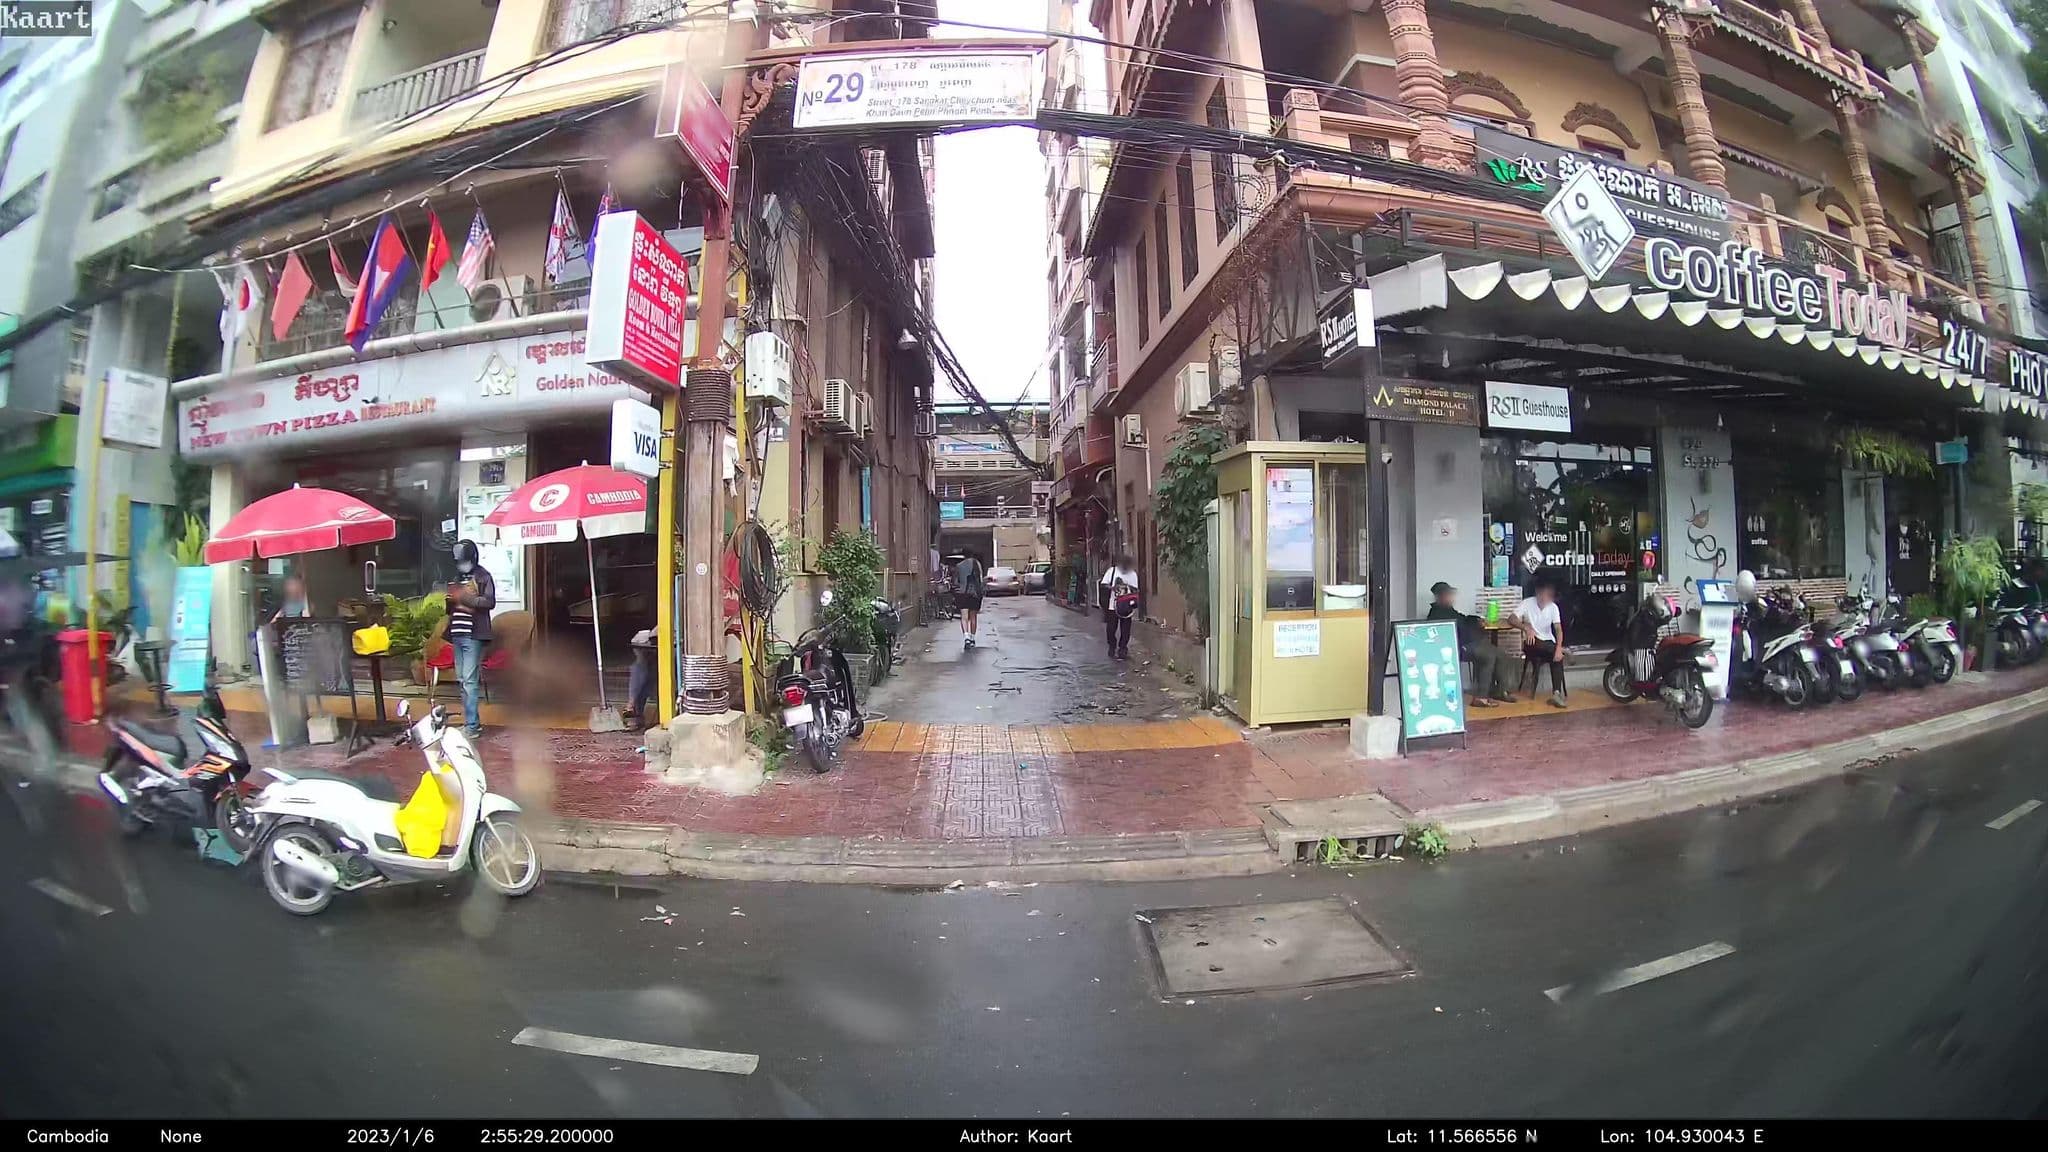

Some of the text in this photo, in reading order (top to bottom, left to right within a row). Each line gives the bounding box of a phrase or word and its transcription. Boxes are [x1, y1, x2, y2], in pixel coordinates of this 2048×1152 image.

[824, 72, 864, 104] 29
[1644, 237, 1823, 324] coffee
[628, 287, 650, 321] GOLDEN
[1338, 311, 1356, 338] HOTEL
[1943, 319, 1987, 375] 24/7
[536, 373, 585, 391] Golden
[1403, 397, 1440, 407] DIAMOND
[1420, 407, 1445, 416] HOTEL
[1522, 398, 1569, 418] Guesthouse
[190, 430, 228, 450] NEW
[291, 409, 359, 432] PIZZA
[634, 431, 657, 460] VISA
[586, 489, 642, 506] CAMBODIA
[520, 523, 558, 539] CAMBODIA
